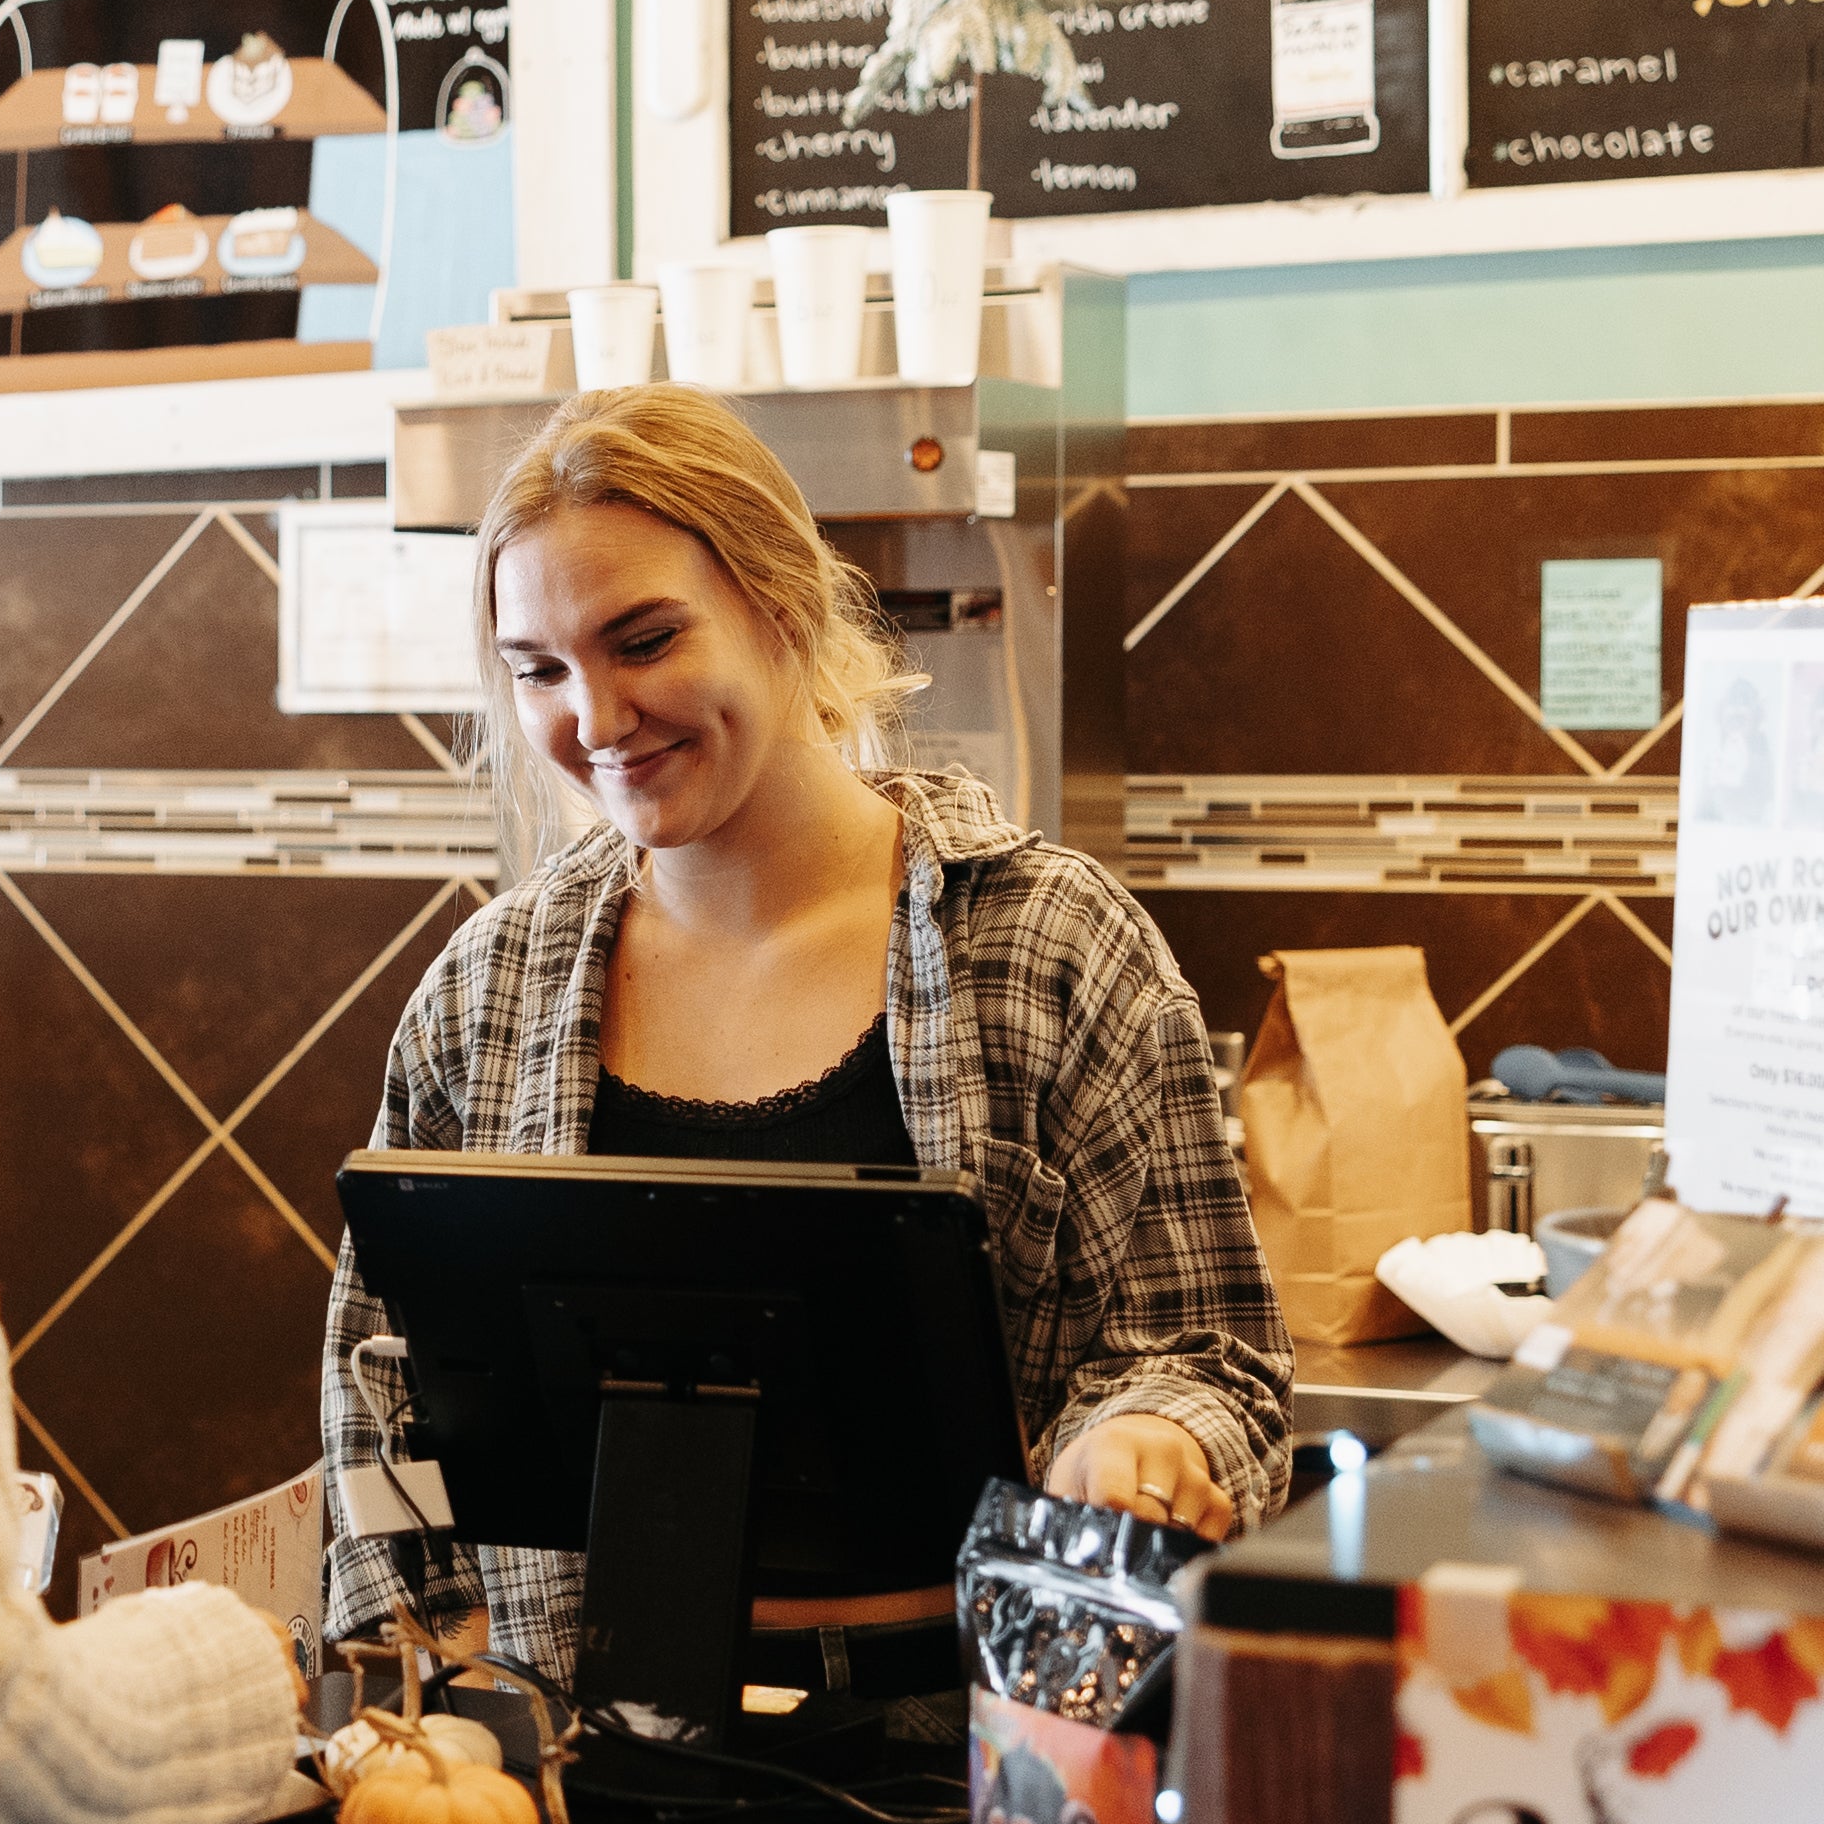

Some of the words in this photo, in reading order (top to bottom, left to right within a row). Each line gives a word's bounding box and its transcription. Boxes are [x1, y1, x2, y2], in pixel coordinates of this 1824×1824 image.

[1504, 47, 1678, 89] caramel
[1039, 96, 1180, 134] lavender
[765, 127, 897, 174] cherry
[1507, 121, 1715, 167] chocolate
[1039, 156, 1138, 193] lemon
[765, 181, 911, 218] cinnamo
[1718, 858, 1780, 902] NOW
[1791, 857, 1824, 889] RO
[1707, 899, 1759, 939] OUR
